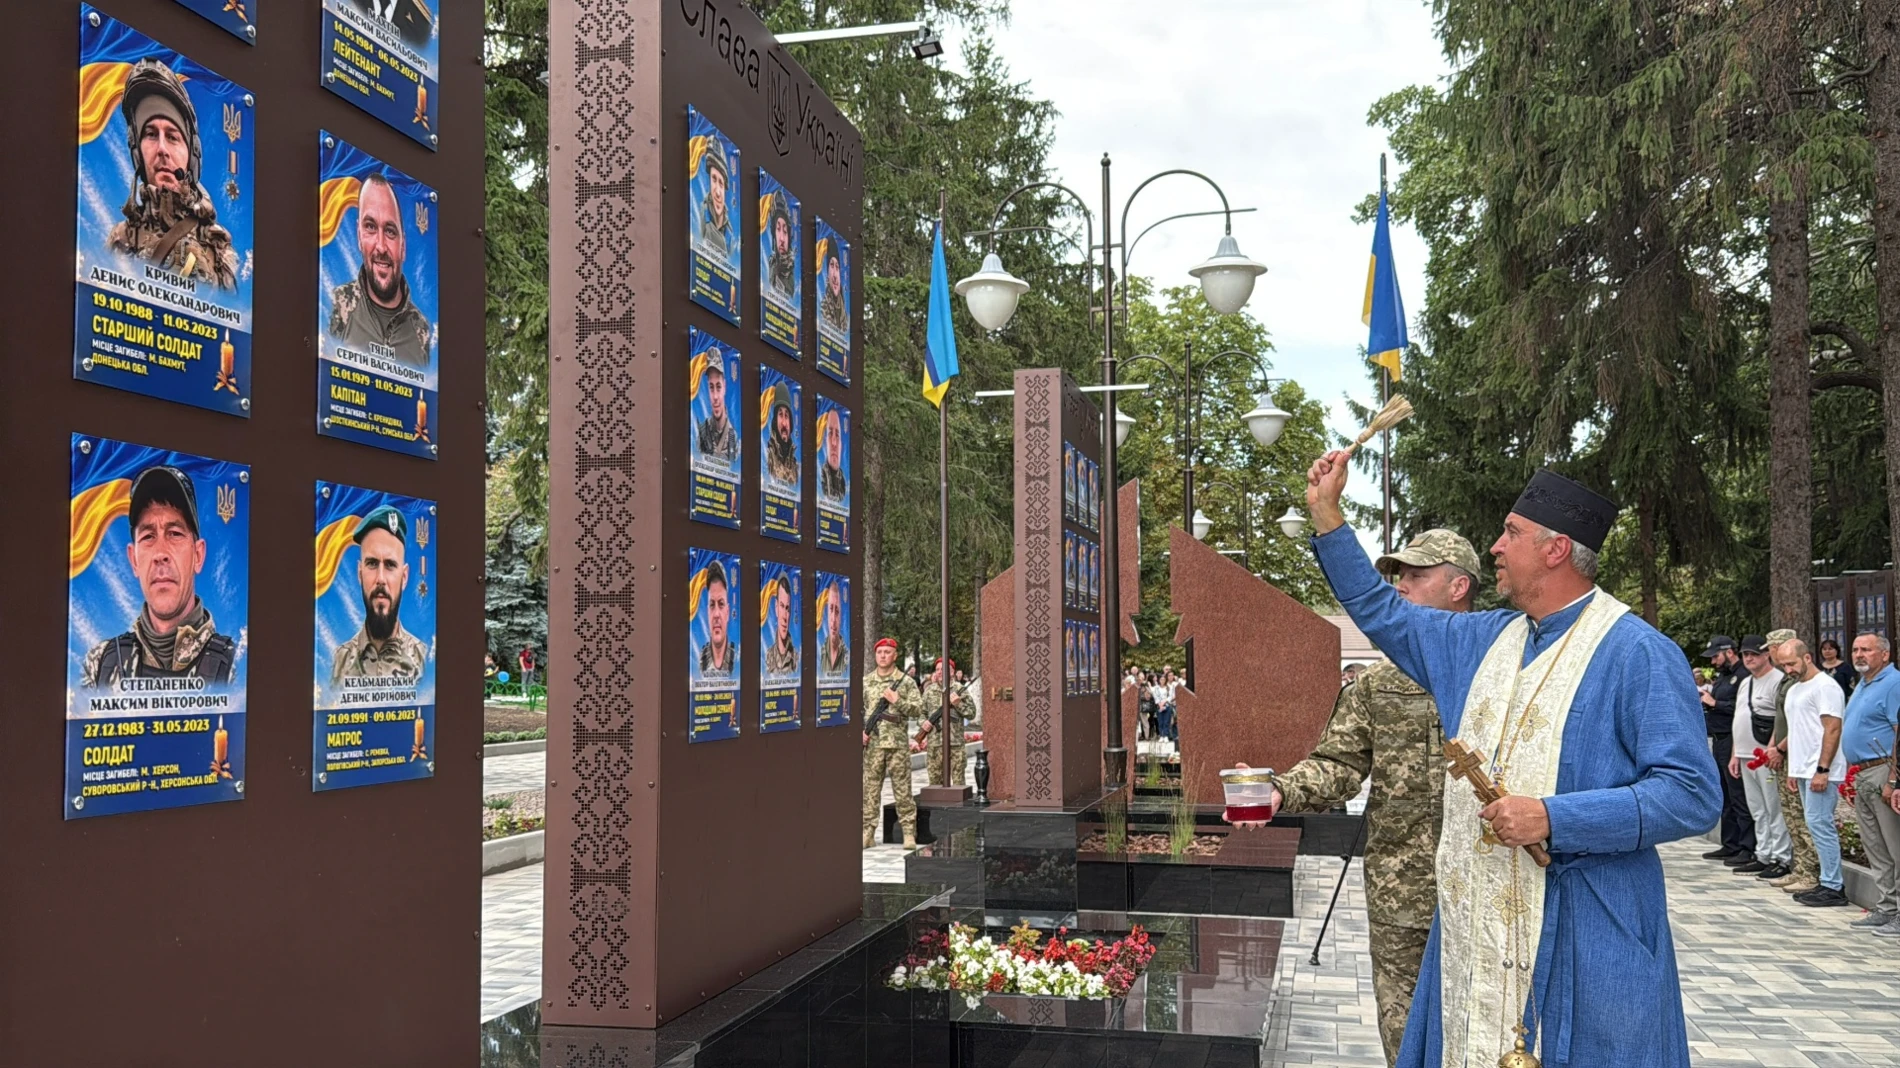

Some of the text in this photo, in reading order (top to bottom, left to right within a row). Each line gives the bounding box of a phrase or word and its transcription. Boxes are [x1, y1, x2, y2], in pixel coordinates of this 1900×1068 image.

[368, 8, 400, 38] МАХТІН
[336, 2, 428, 71] МАКСИМ ВАСИЛЬОВИЧ
[334, 20, 374, 54] 14.05.1984
[378, 48, 418, 83] 06.05.2023
[334, 38, 382, 79] ЛЕЙТЕНАНТ
[796, 82, 855, 185] Україні
[145, 265, 196, 293] КРИВИЙ
[91, 266, 242, 324] ДЕНИС ОЛЕКСАНДРОВИЧ
[92, 292, 154, 321] 19.10.1988
[163, 313, 218, 340] 11.05.2023
[92, 314, 203, 361] СТАРШИЙ СОЛДАТ
[92, 338, 186, 372] МІСЦЕ ЗАГИБЕЛІ: М. БАХМУТ,
[370, 342, 395, 360] ТЯГІЙ
[92, 352, 149, 376] ДОНЕЦЬКА ОБЛ.
[336, 348, 425, 383] СЕРГІЙ ВАСИЛЬОВИЧ
[330, 366, 370, 386] 15.01.1979
[375, 379, 413, 398] 11.05.2023
[330, 384, 366, 406] КАПІТАН
[120, 678, 204, 692] СТЕПАНЕНКО
[345, 676, 414, 688] КЕЛЬМАНСЬКИЙ
[90, 695, 228, 711] МАКСИМ ВІКТОРОВИЧ
[341, 690, 417, 704] ДЕНИС ЮРІЙОВИЧ
[83, 722, 145, 738] 27.12.1983
[152, 718, 210, 734] 31.05.2023
[327, 712, 368, 725] 21.09.1991
[373, 710, 416, 722] 09.06.2023
[327, 730, 362, 747] МАТРОС
[83, 745, 135, 766] СОЛДАТ
[83, 764, 180, 782] МІСЦЕ ЗАГИБЕЛІ: М. ХЕРСОН,
[82, 779, 141, 797] СУВОРОВСЬКИЙ
[161, 775, 203, 789] ХЕРСОНСЬКА
[204, 774, 218, 784] ОБЛ.
